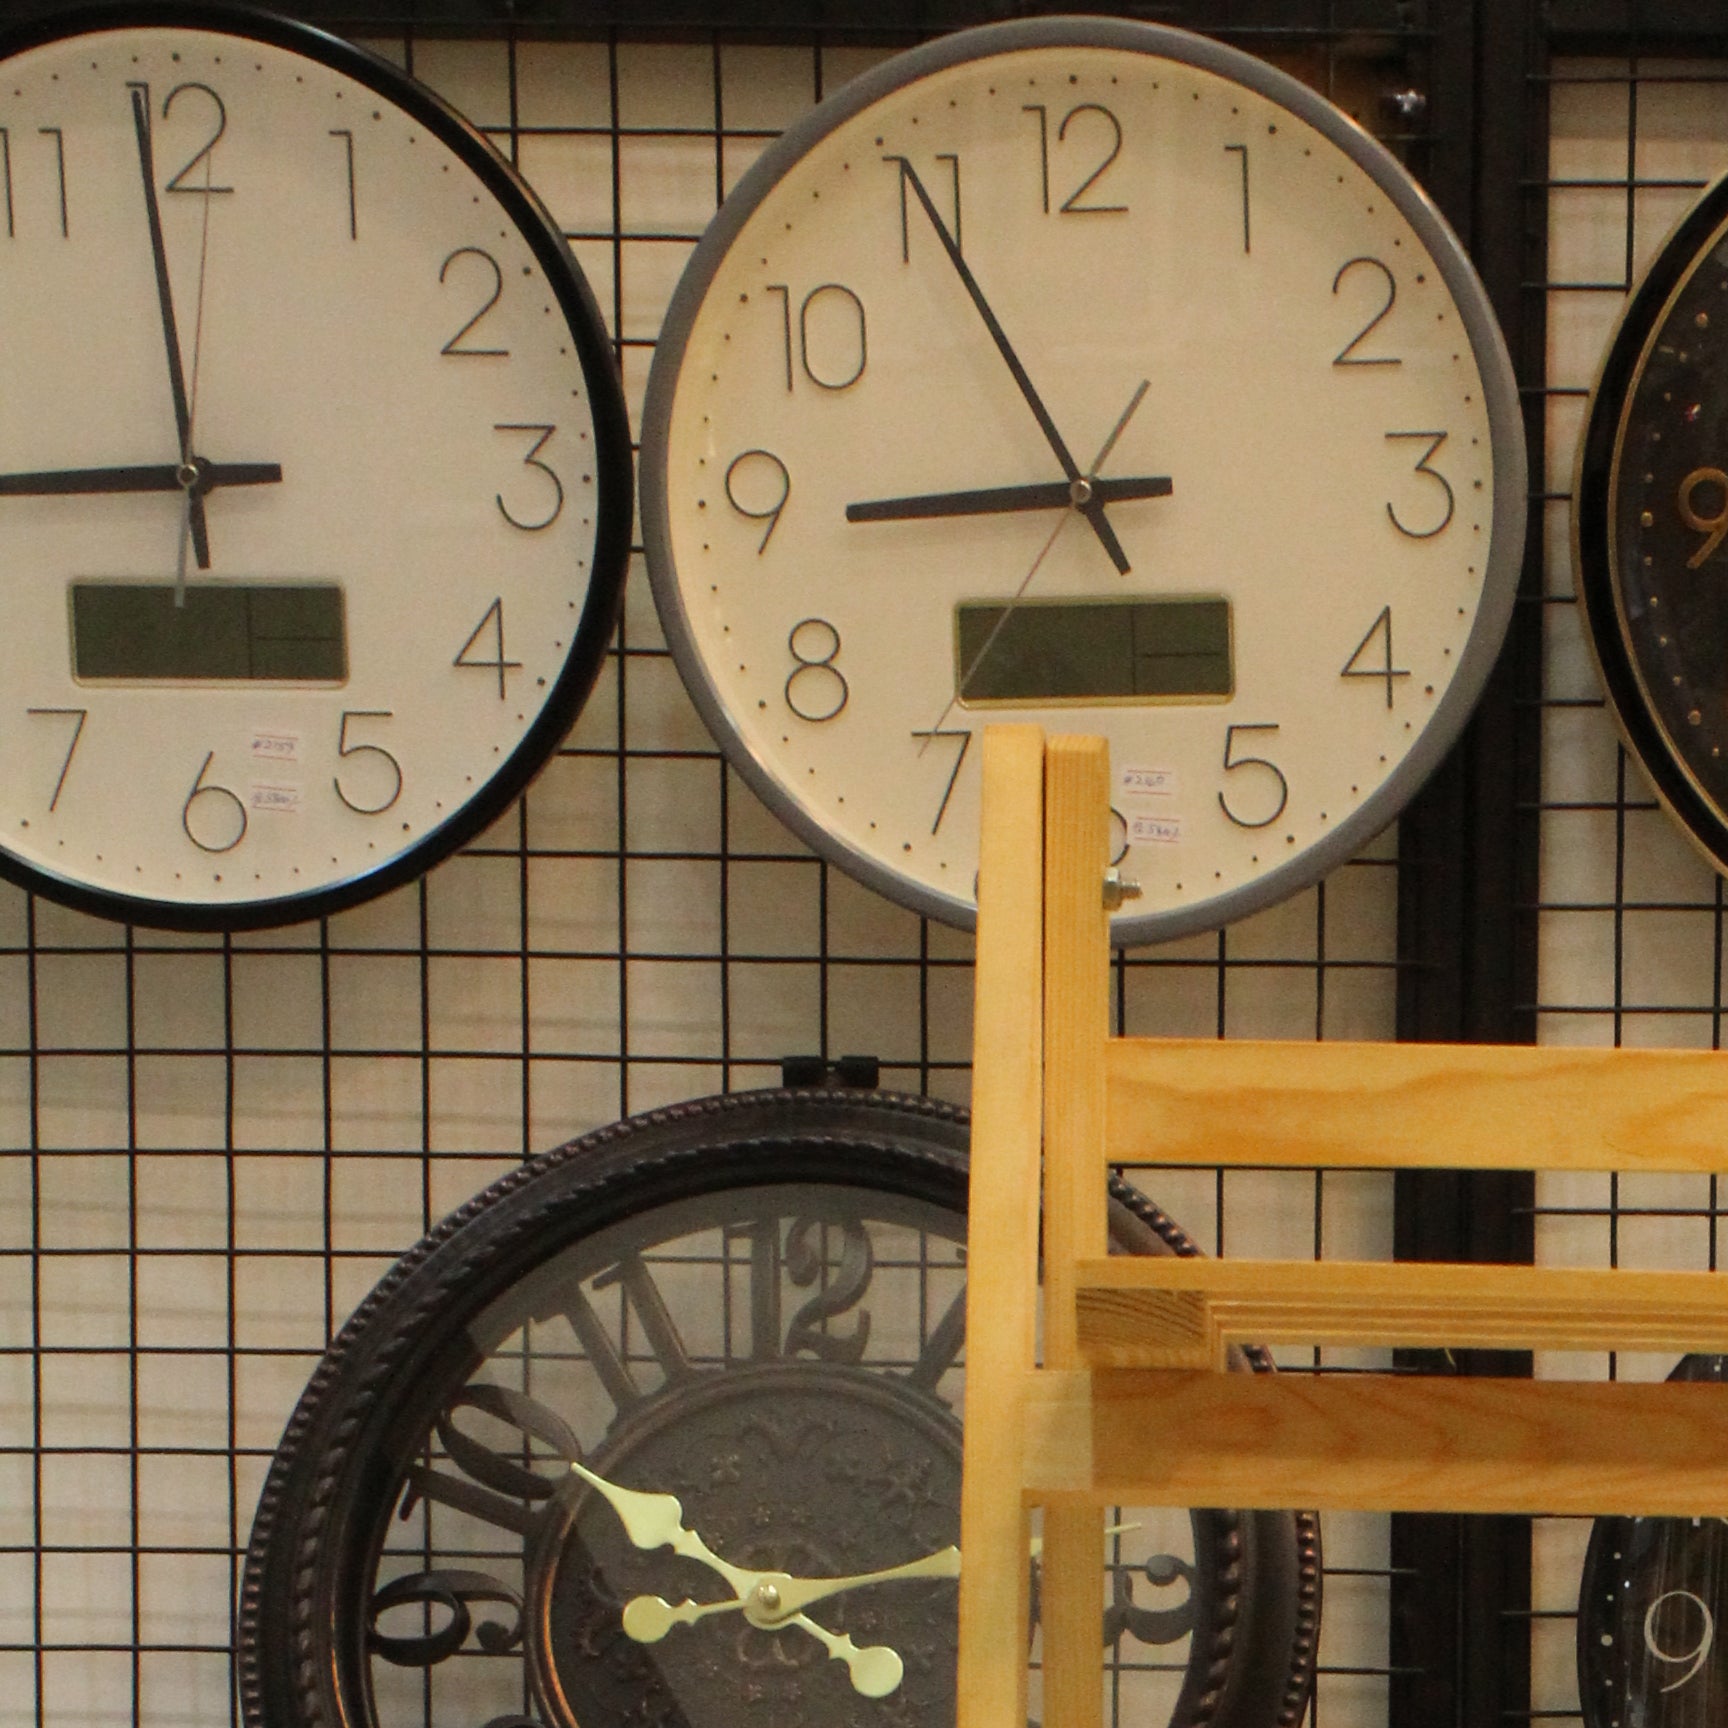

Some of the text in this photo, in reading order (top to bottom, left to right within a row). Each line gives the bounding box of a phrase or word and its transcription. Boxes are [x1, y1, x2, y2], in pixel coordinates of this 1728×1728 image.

[0, 127, 68, 239] 11
[125, 82, 234, 194] 12
[329, 130, 357, 241] 1
[1023, 104, 1129, 214] 12
[883, 154, 963, 264] 11
[1225, 145, 1251, 254] 1
[439, 248, 510, 356] 2
[766, 283, 866, 392] 10
[1333, 256, 1403, 366] 2
[494, 425, 564, 532] 3
[725, 449, 791, 555] 9
[1386, 431, 1455, 539] 3
[453, 597, 522, 700] 4
[784, 618, 849, 721] 8
[1341, 605, 1412, 710] 4
[27, 708, 88, 812] 7
[183, 751, 248, 853] 6
[334, 711, 402, 814] 5
[911, 730, 972, 836] 7
[1219, 723, 1289, 828] 5
[531, 1252, 708, 1415] 11
[727, 1213, 873, 1366] 12
[396, 1383, 585, 1535] 10
[368, 1567, 526, 1667] 9
[1644, 1591, 1714, 1694] 9
